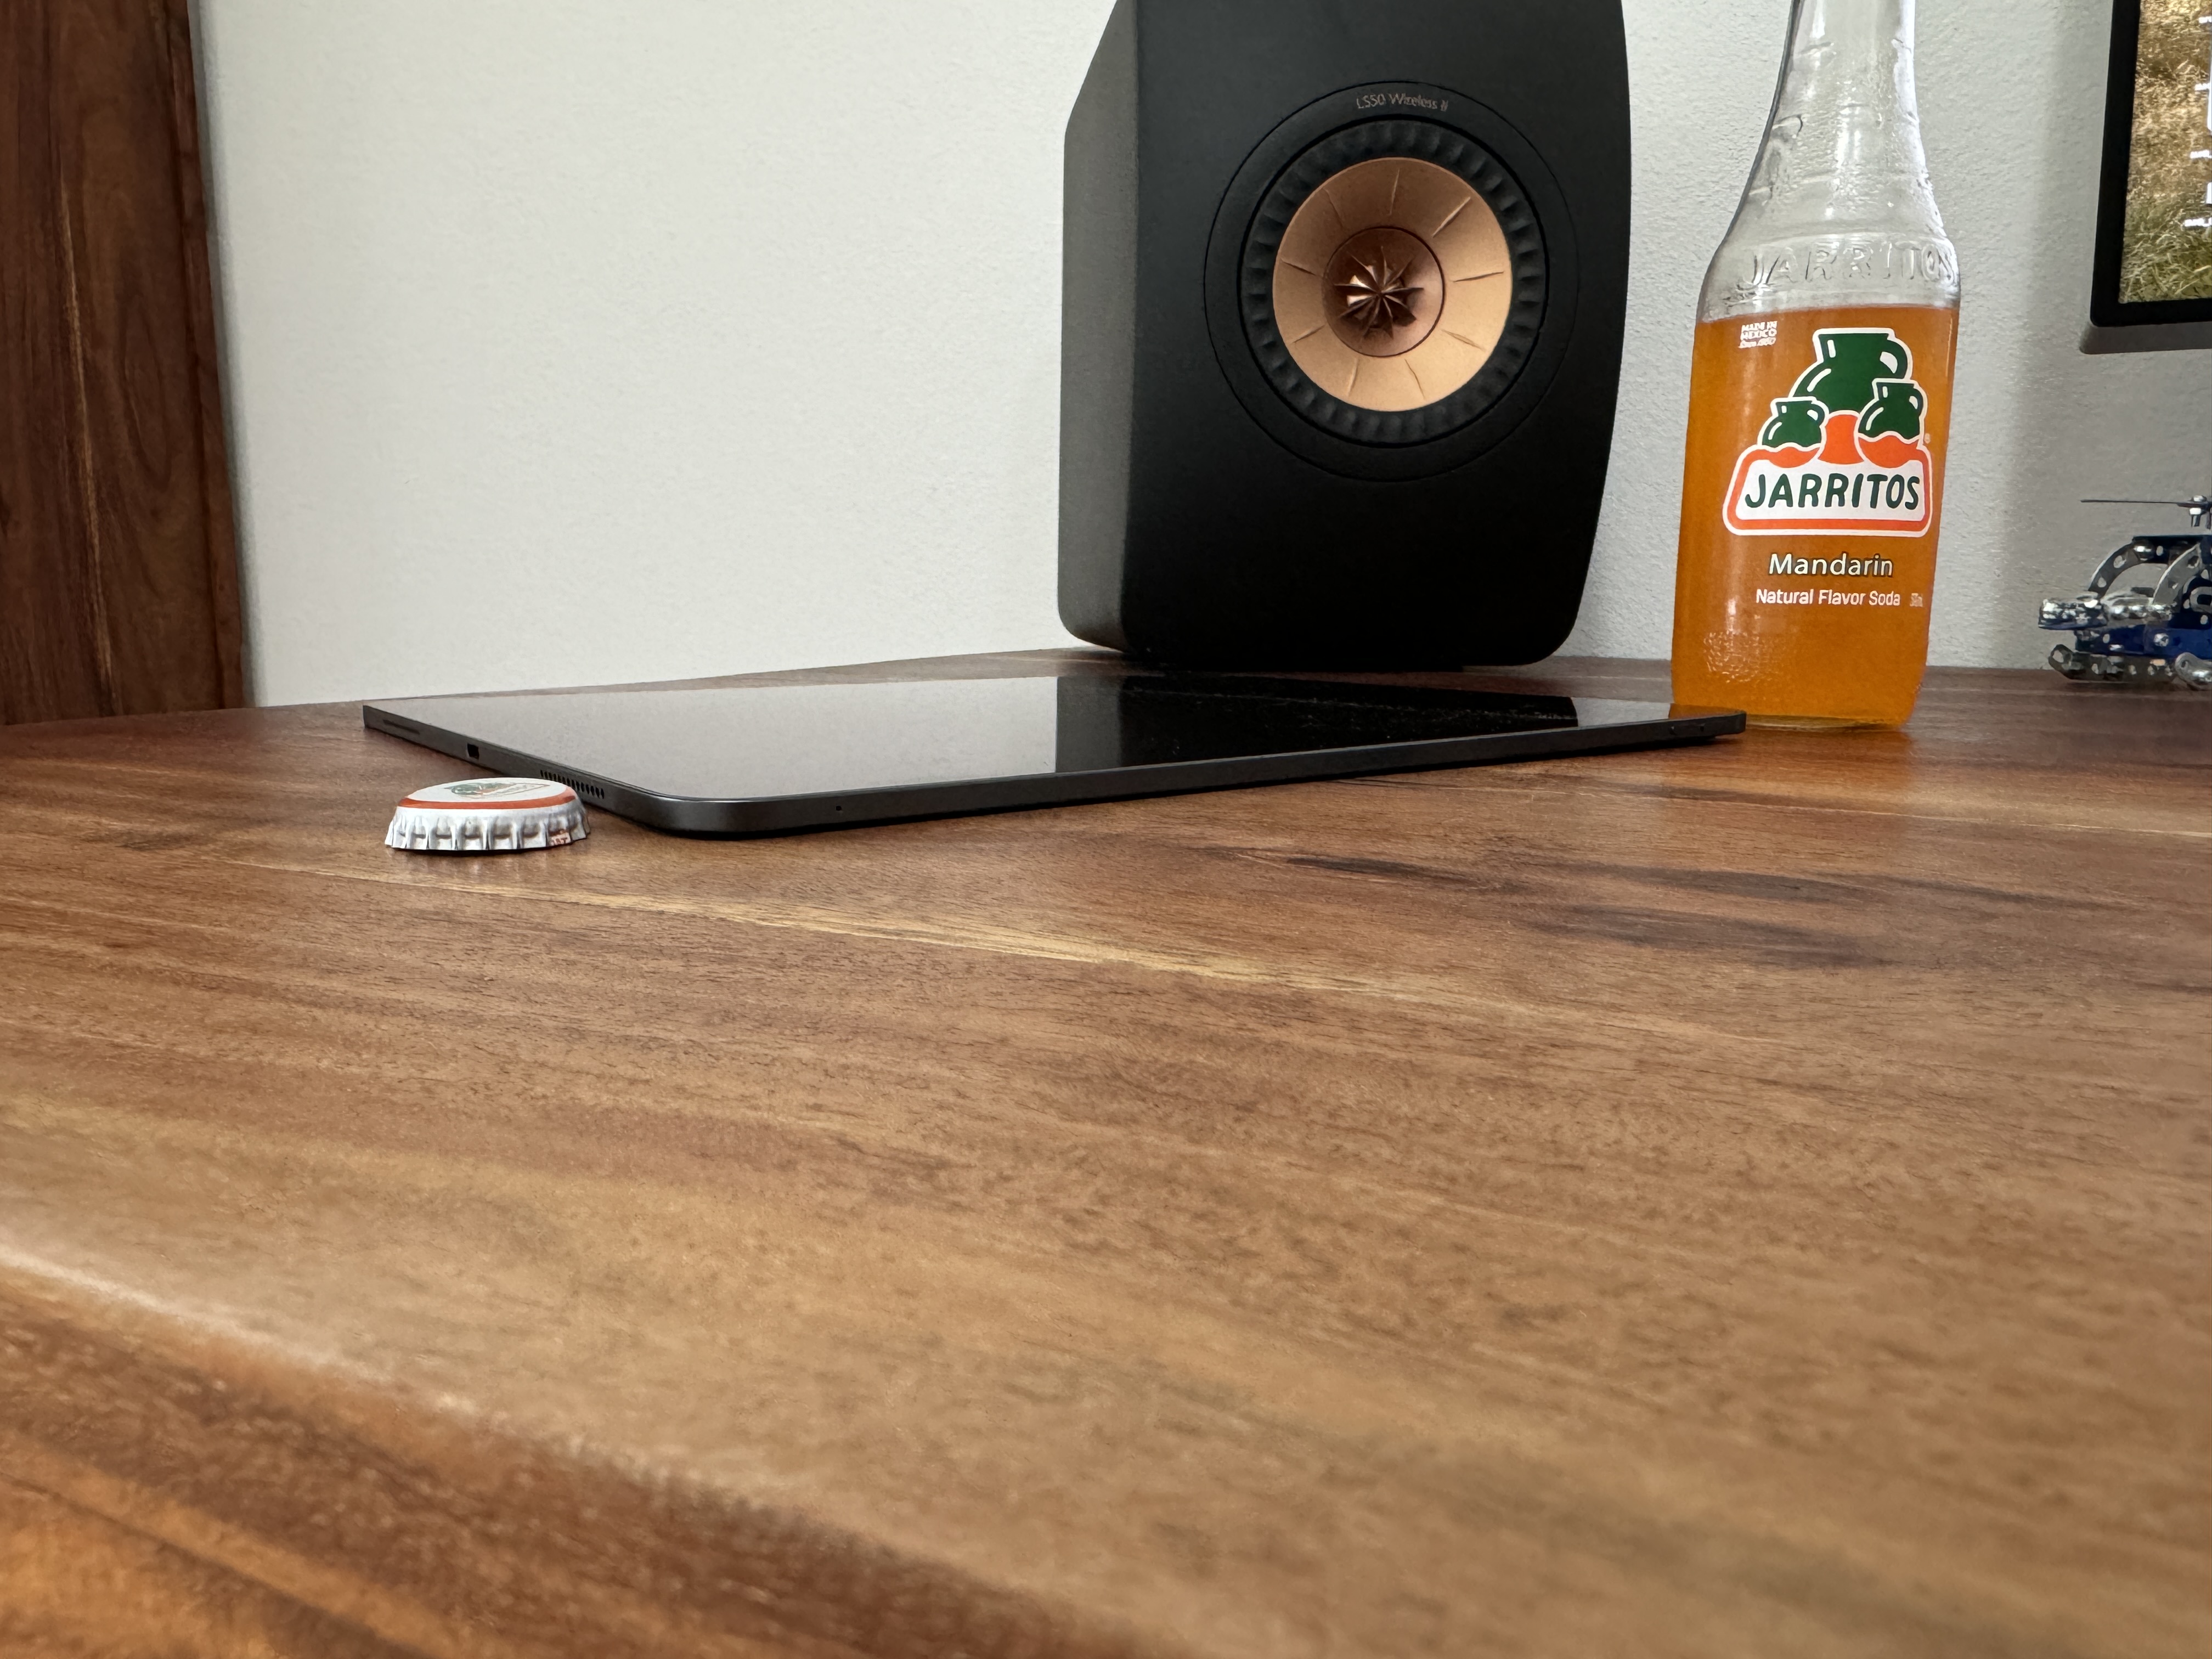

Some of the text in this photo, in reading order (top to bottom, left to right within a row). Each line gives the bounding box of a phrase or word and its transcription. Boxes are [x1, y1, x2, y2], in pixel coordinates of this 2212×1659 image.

[1356, 93, 1386, 109] LS50
[1742, 242, 1959, 284] JARRITOS
[1745, 473, 1920, 510] JARRITOS
[1769, 552, 1893, 577] Mandarin
[1756, 588, 1814, 604] Natural
[1818, 589, 1866, 605] Flavor
[1869, 590, 1901, 606] Soda
